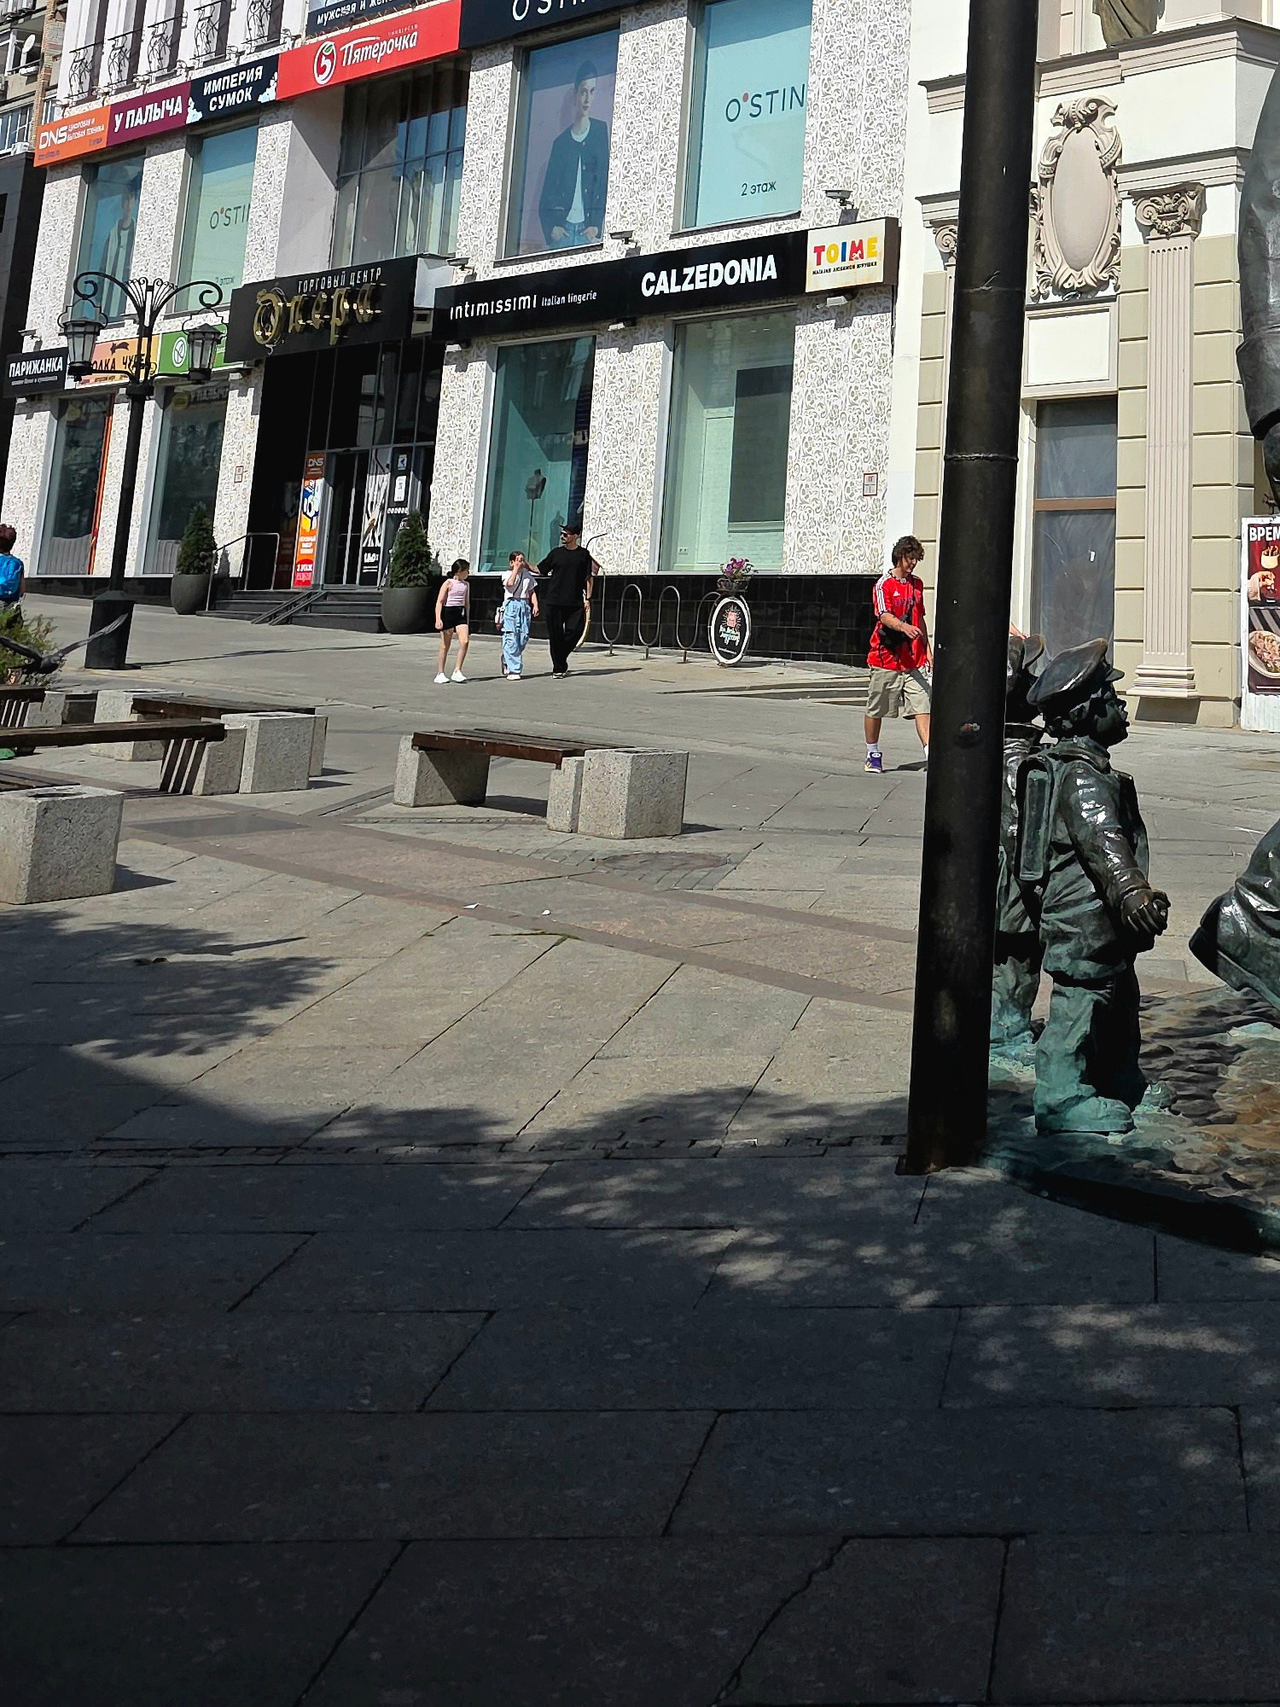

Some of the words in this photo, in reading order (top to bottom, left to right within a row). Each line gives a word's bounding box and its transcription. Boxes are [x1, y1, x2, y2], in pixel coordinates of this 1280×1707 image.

[316, 3, 357, 27] мужская
[360, 0, 366, 11] и
[340, 31, 418, 67] Пятерочка
[203, 65, 264, 96] ИМПЕРИЯ
[209, 86, 253, 112] СУМОК
[114, 113, 122, 133] У
[125, 95, 183, 129] ПАЛЫЧА
[39, 125, 68, 150] DNS
[741, 182, 748, 196] 2
[750, 181, 777, 195] этаж
[297, 270, 347, 294] ТОРГОВЫЙ
[349, 267, 382, 287] ЦЕНТР
[641, 254, 778, 298] CALZEDONIA
[450, 294, 537, 320] intimissimi
[567, 289, 597, 304] lingerie
[9, 356, 63, 378] ПАРИЖАНКА
